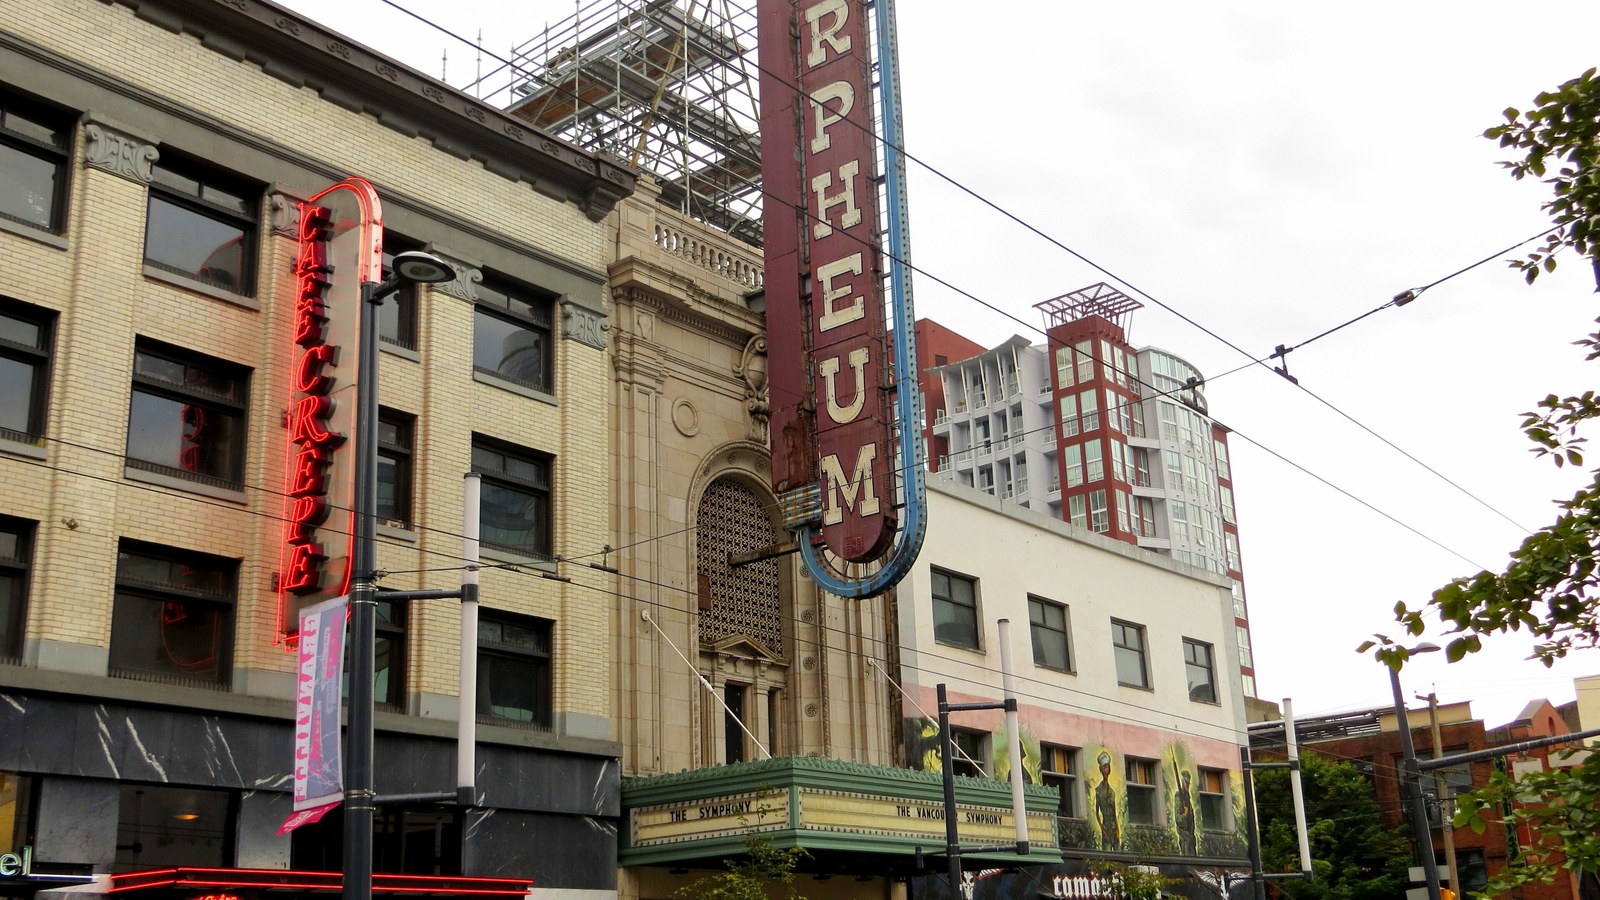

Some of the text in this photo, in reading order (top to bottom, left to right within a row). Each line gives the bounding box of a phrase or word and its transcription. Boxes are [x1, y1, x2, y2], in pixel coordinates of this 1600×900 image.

[283, 206, 346, 592] CAFÉ CRÊPE
[670, 801, 751, 822] THE SYMPHONY
[896, 805, 1003, 825] THE VANCOU SYMPHONY
